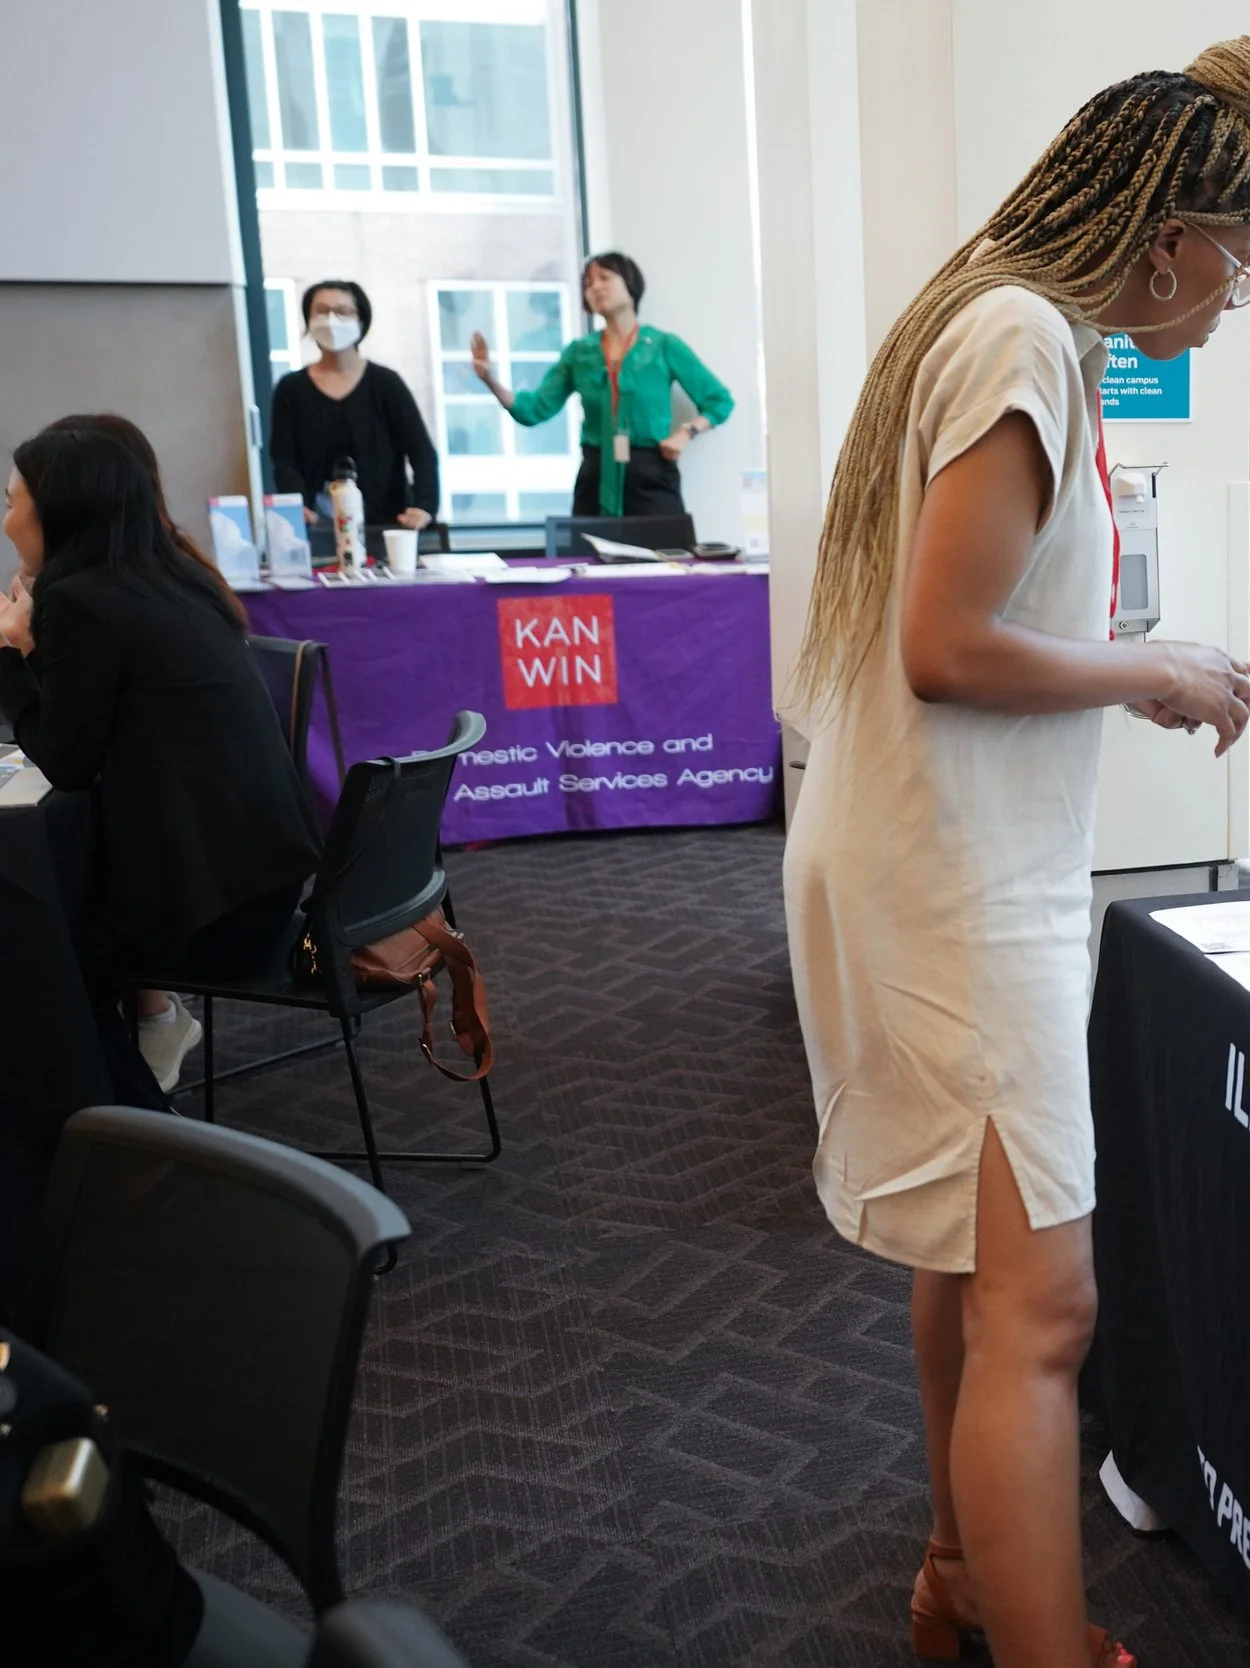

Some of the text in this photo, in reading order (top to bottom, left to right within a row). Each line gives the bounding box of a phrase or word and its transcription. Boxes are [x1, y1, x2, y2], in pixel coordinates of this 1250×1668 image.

[1103, 333, 1136, 349] anit
[1100, 387, 1163, 395] tarts with clean
[1102, 376, 1159, 386] clean campus
[1101, 398, 1120, 406] ands
[515, 615, 600, 649] KAN
[517, 654, 602, 688] WIN
[411, 733, 713, 767] mestic Violence and
[454, 765, 774, 802] Assault Services Agency
